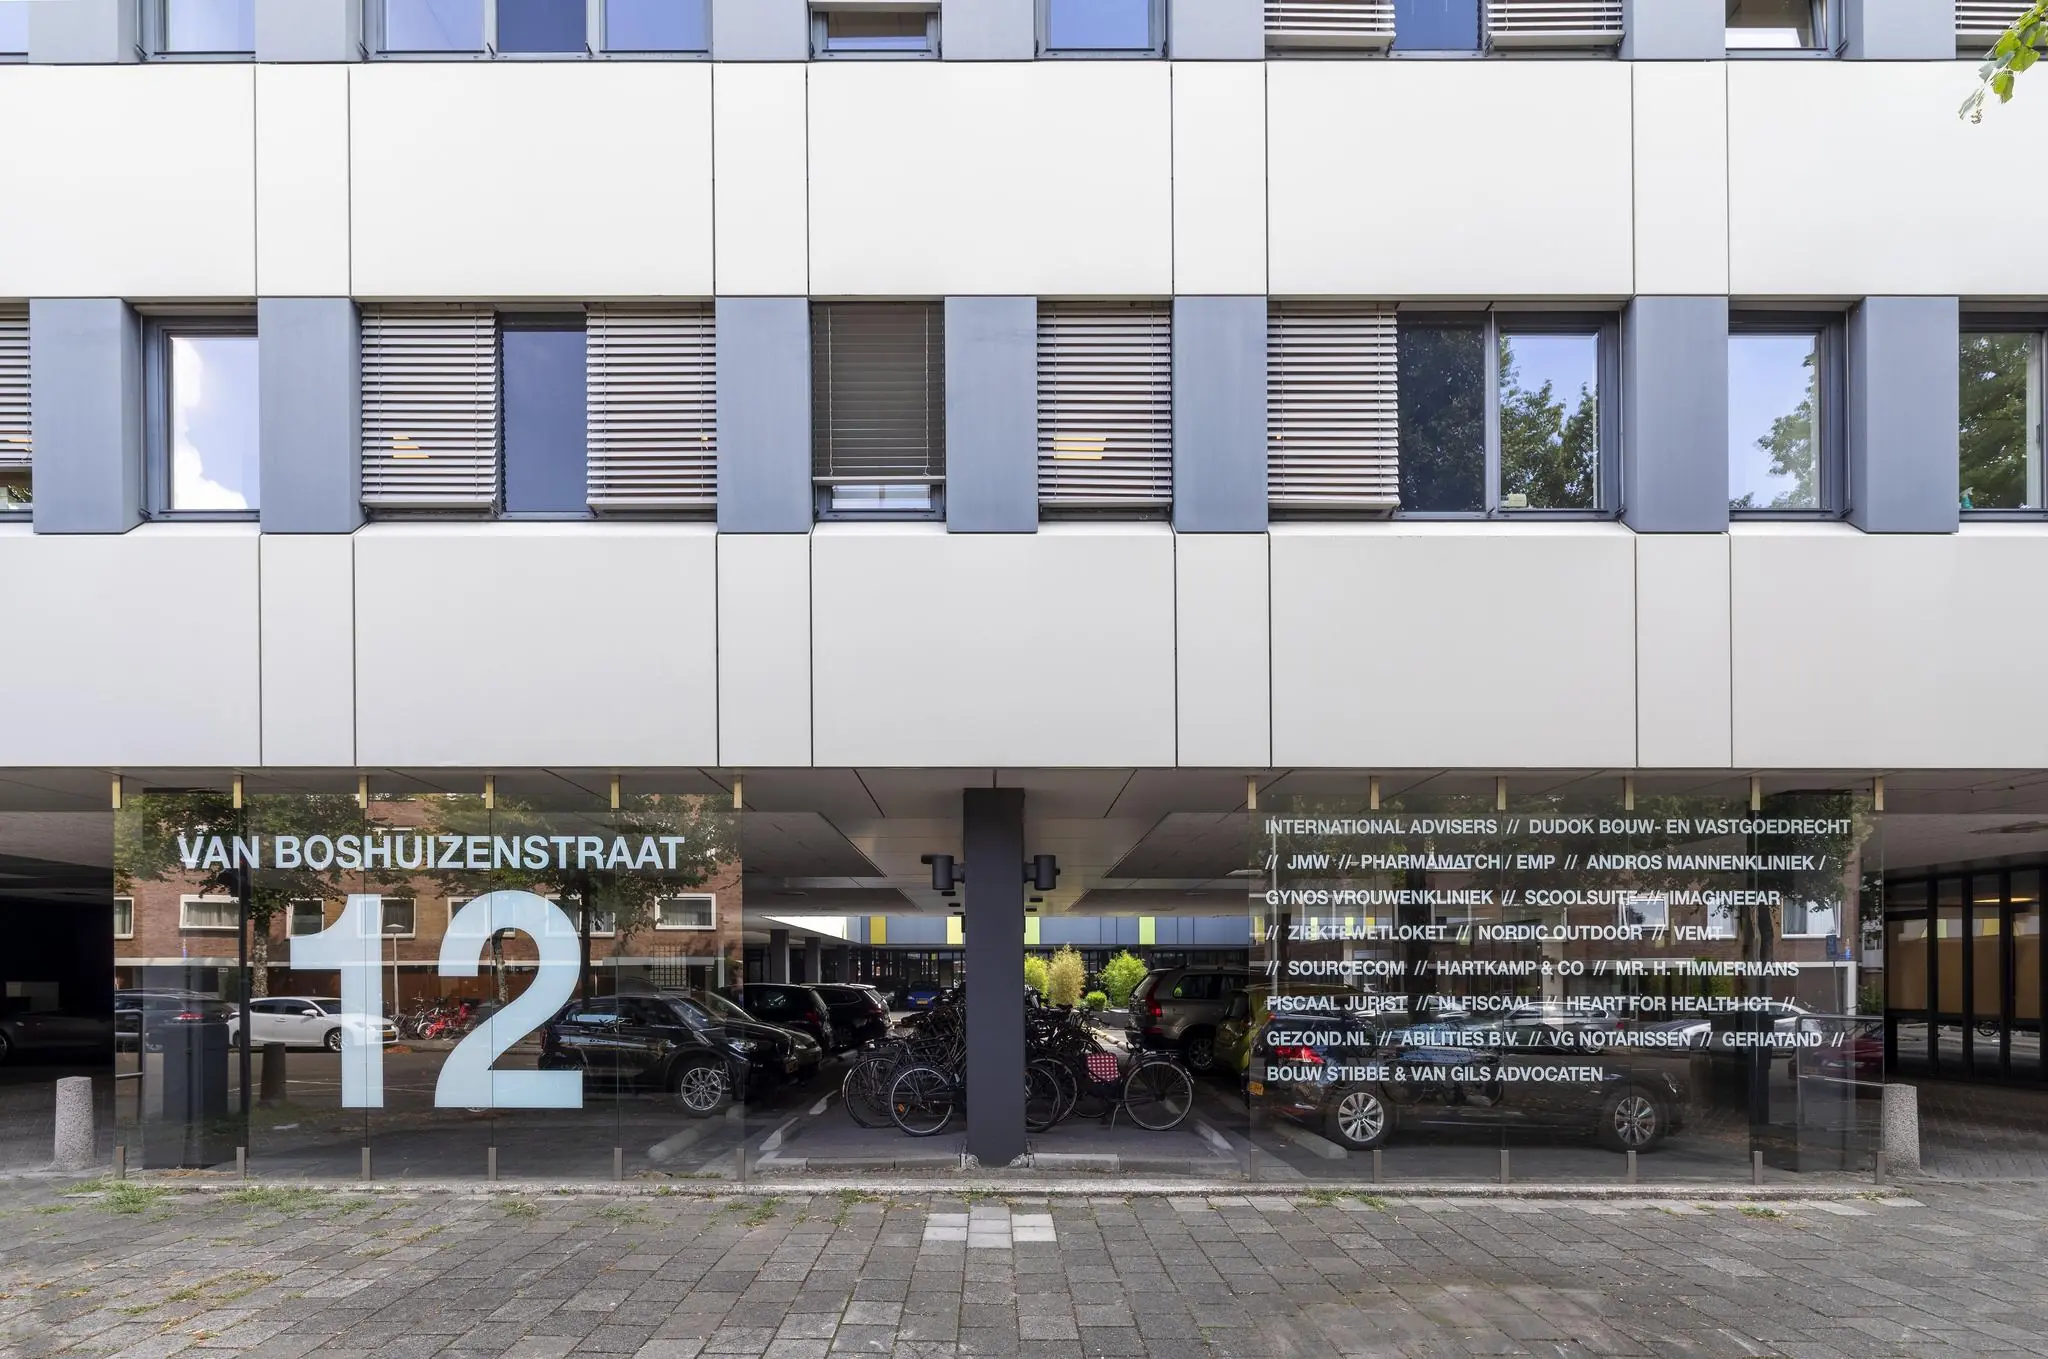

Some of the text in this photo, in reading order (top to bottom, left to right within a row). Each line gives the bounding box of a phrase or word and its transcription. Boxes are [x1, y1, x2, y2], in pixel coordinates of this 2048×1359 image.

[1265, 819, 1850, 834] INTERNATIONAL ADVISERS // DUDOK BOUW- EN VASTGOEDRECHT
[178, 835, 684, 869] VAN BOSHUIZENSTRAAT
[1265, 855, 1278, 869] //
[1288, 855, 1329, 869] JMW
[1339, 855, 1351, 869] //
[1361, 855, 1499, 869] PHARMAMATCH
[1517, 855, 1555, 869] EMP
[1564, 855, 1577, 869] //
[1587, 855, 1662, 869] ANDROS
[1668, 855, 1814, 869] MANNENKLINIEK
[1266, 890, 1780, 905] GYNOS VROUWENKLINIEK // SCOOLSUITE // IMAGINEEAR
[1266, 925, 1723, 940] // ZIEKTEWETLOKET // NORDIC OUTDOOR // VEMT
[1266, 961, 1799, 976] // SOURCECOM // HARTKAMP & CO // MR. H. TIMMERMANS
[290, 890, 583, 1108] 12
[1267, 996, 1340, 1011] FISCAAL
[1344, 996, 1405, 1011] JURIST
[1416, 996, 1429, 1011] //
[1545, 996, 1557, 1011] //
[1567, 996, 1626, 1011] HEART
[1633, 996, 1666, 1011] FOR
[1672, 996, 1737, 1011] HEALTH
[1744, 996, 1772, 1011] ICT
[1782, 996, 1795, 1011] //
[1267, 1031, 1844, 1047] GEZOND.NL // ABILITIES B.V. // VG NOTARISSEN // GERIATAND //
[1268, 1066, 1603, 1082] BOUW STIBBE & VAN GILS ADVOCATEN
